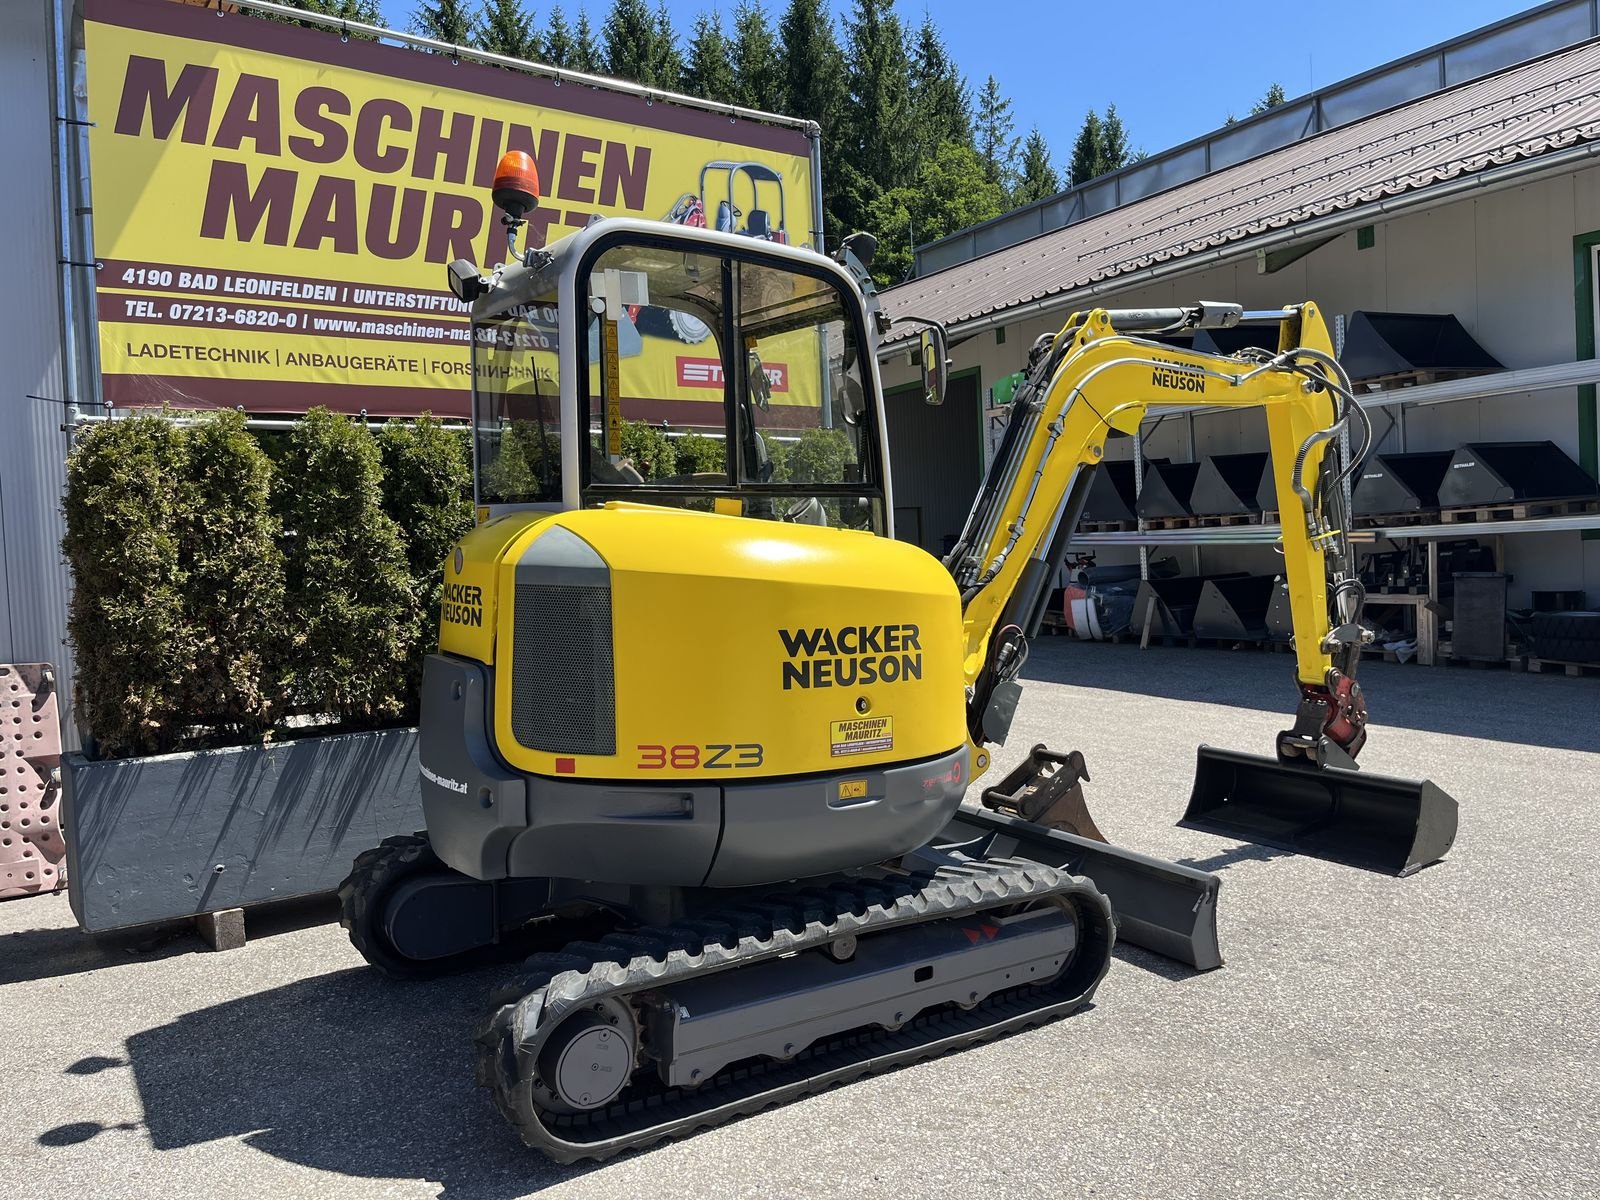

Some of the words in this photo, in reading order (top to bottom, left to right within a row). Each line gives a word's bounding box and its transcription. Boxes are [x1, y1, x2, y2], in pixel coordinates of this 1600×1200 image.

[114, 55, 652, 211] MASCHINEN
[200, 159, 590, 269] MAURIT
[122, 268, 173, 287] 4190
[178, 272, 218, 290] BAD
[223, 276, 337, 301] LEONFELDEN
[353, 288, 474, 313] UNTERSTIFTUN
[125, 300, 163, 318] TEL.
[169, 303, 298, 329] 07213-6820-0
[313, 317, 472, 341] www.maschinen-ma
[127, 342, 271, 365] LADETECHNIK
[285, 351, 419, 373] ANBAUGERÄTE
[1152, 372, 1205, 393] NEUSON
[778, 624, 922, 658] WACKER
[782, 653, 922, 690] NEUSON
[839, 718, 888, 732] MASCHINEN
[845, 729, 882, 741] MAURITZ
[637, 743, 764, 769] 38Z3
